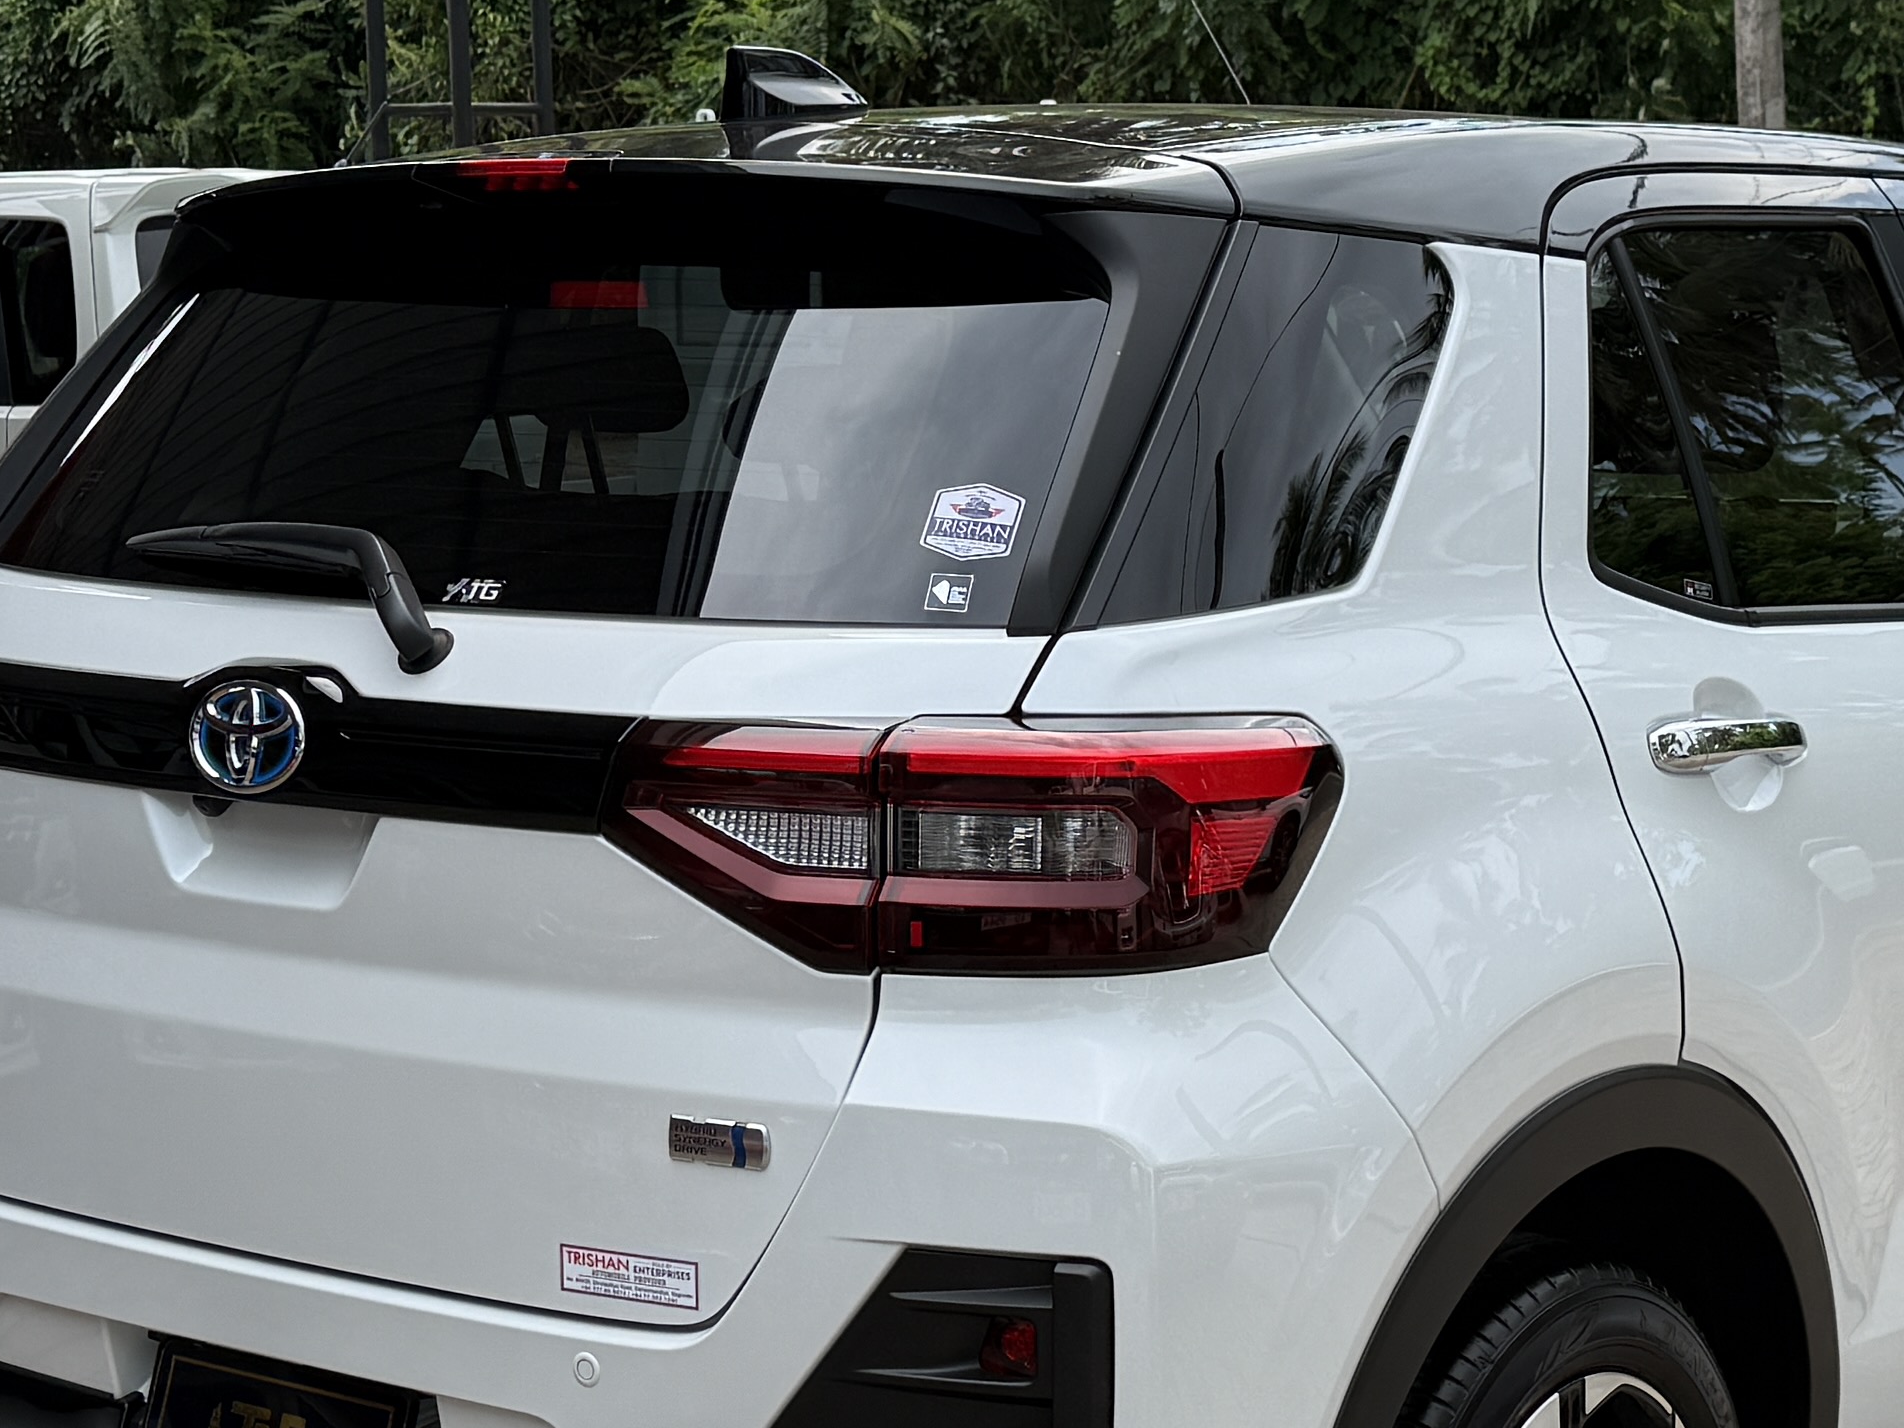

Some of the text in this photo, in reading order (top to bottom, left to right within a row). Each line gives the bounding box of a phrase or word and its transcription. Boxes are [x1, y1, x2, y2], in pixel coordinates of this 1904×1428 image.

[934, 517, 1011, 539] TRISHAN
[674, 1134, 726, 1148] SYNERGY
[674, 1144, 707, 1156] DRIVE
[566, 1250, 630, 1272] TRISHAN
[633, 1265, 691, 1281] ENTERPRISES
